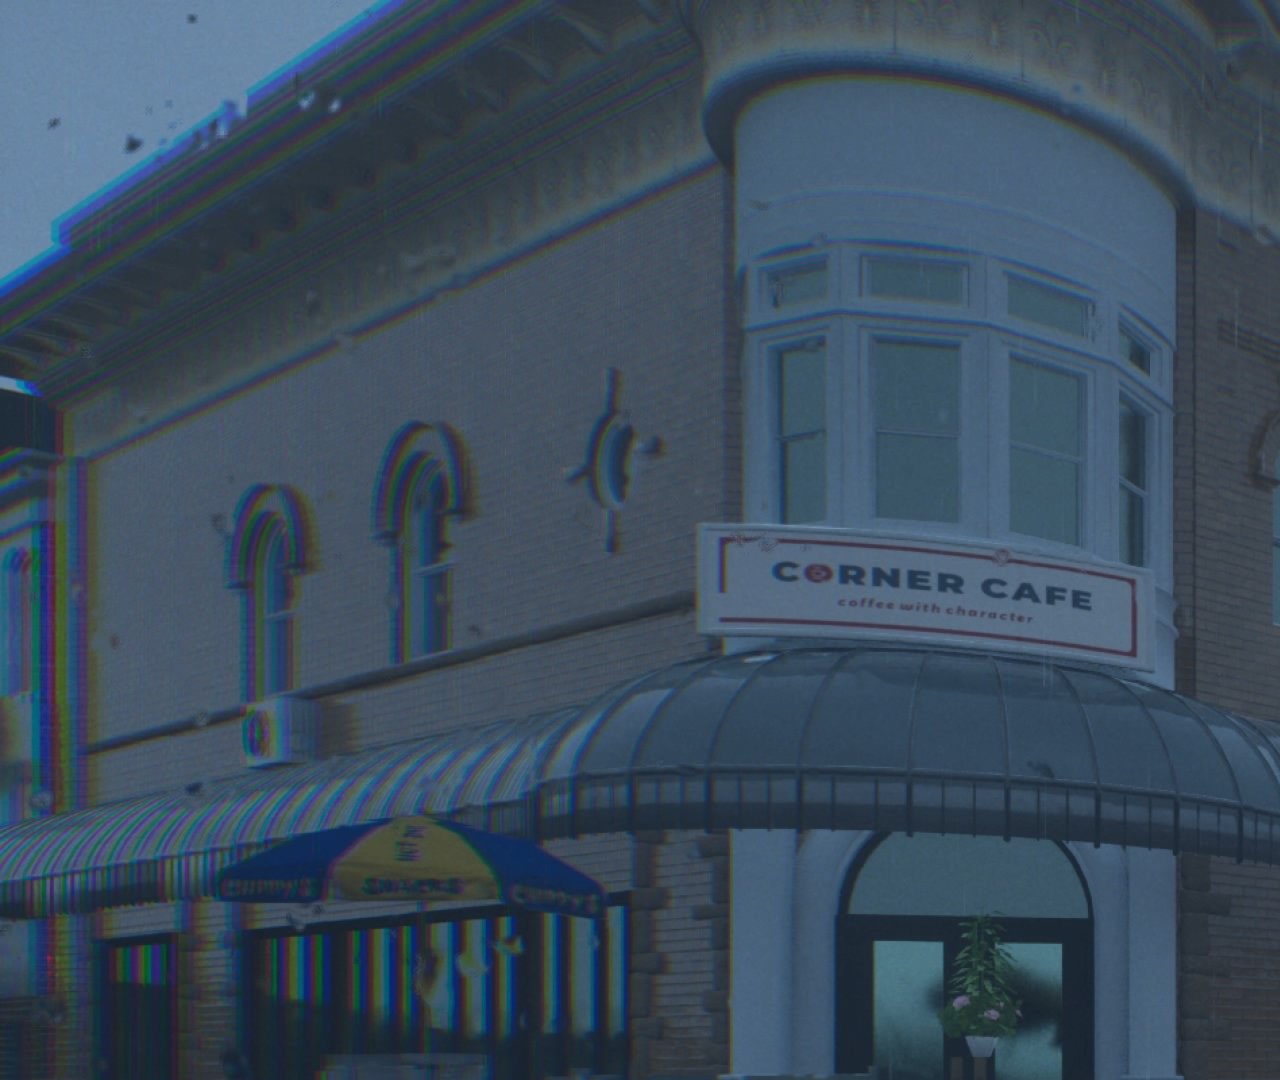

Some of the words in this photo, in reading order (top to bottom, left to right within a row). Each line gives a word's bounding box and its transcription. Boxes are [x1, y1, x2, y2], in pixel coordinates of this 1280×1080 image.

[772, 561, 965, 594] CORNER
[981, 577, 1093, 611] CAFE
[837, 596, 895, 612] coffee
[900, 601, 941, 614] with
[945, 606, 1034, 624] character
[361, 877, 466, 896] SNACKS
